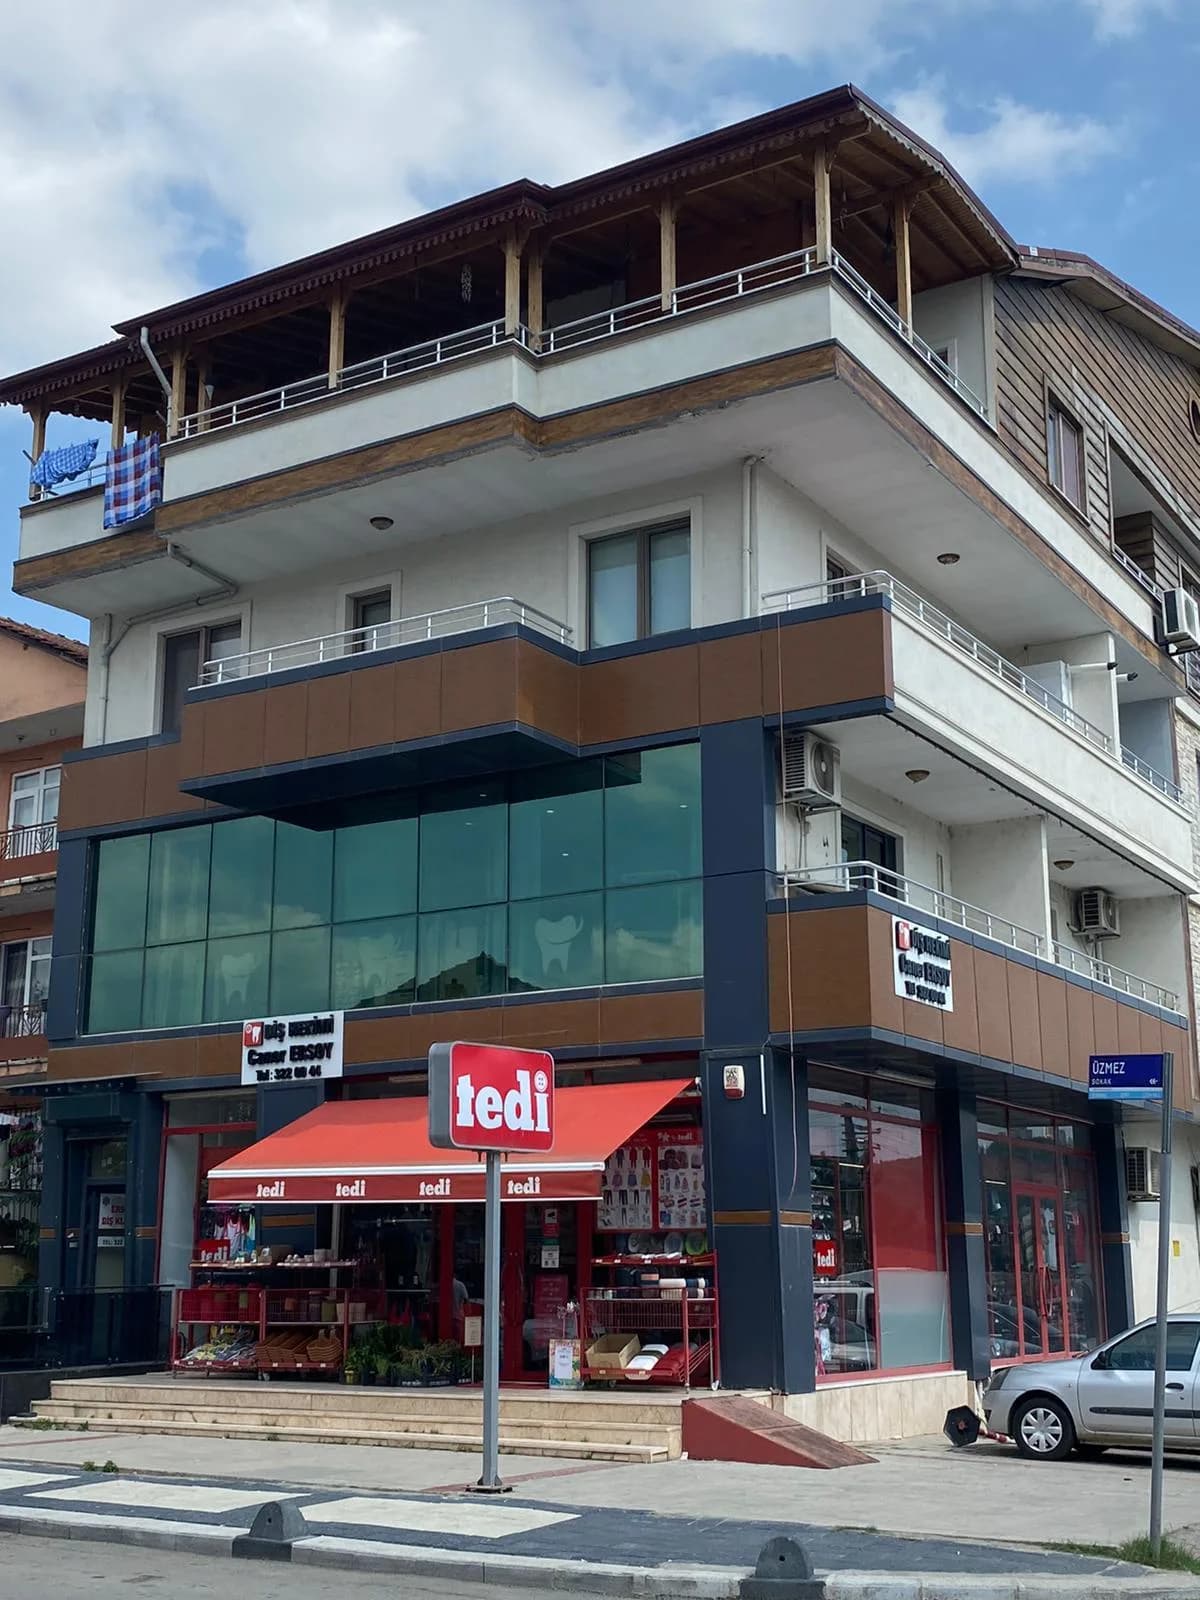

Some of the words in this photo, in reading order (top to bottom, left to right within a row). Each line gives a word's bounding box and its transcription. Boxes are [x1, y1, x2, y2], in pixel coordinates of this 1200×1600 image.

[247, 1049, 287, 1065] Caner
[289, 1042, 334, 1062] ERSOY
[1092, 1060, 1126, 1075] ÜZMEZ
[456, 1068, 550, 1132] tedi
[256, 1180, 285, 1197] tedi
[335, 1179, 366, 1197] tedi
[419, 1178, 451, 1196] tedi
[507, 1176, 541, 1194] tedi
[817, 1247, 836, 1267] tedi
